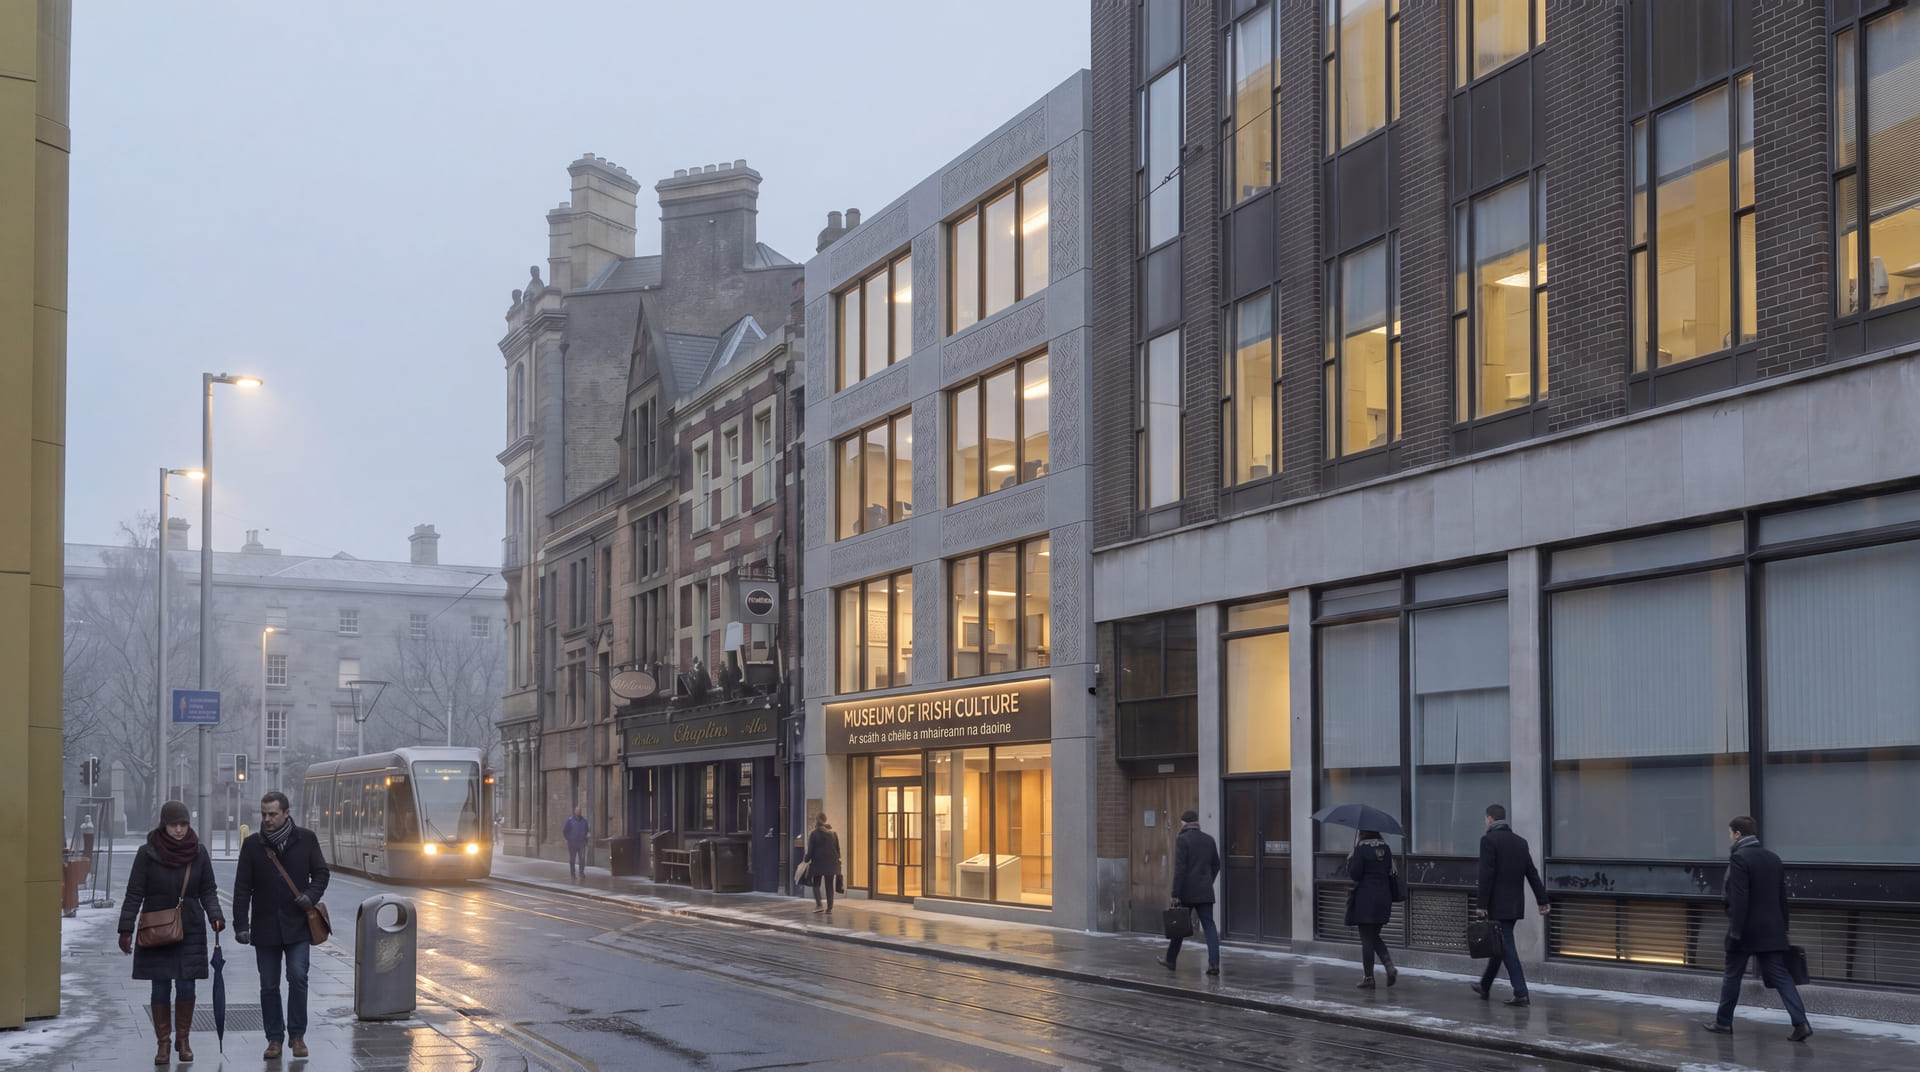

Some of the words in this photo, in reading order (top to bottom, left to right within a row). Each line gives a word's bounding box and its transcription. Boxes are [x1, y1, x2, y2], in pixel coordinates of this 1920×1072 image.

[844, 706, 895, 728] MUSEUM
[897, 704, 915, 723] OF
[918, 699, 952, 721] IRISH
[955, 693, 1019, 718] CULTURE
[673, 720, 728, 744] Chaplins
[848, 734, 858, 745] Ar
[859, 731, 880, 744] scáth
[881, 733, 886, 742] a
[888, 729, 911, 742] chéile
[913, 731, 918, 740] a
[920, 726, 965, 739] mhaireann
[967, 725, 978, 736] na
[980, 721, 1011, 735] daoine
